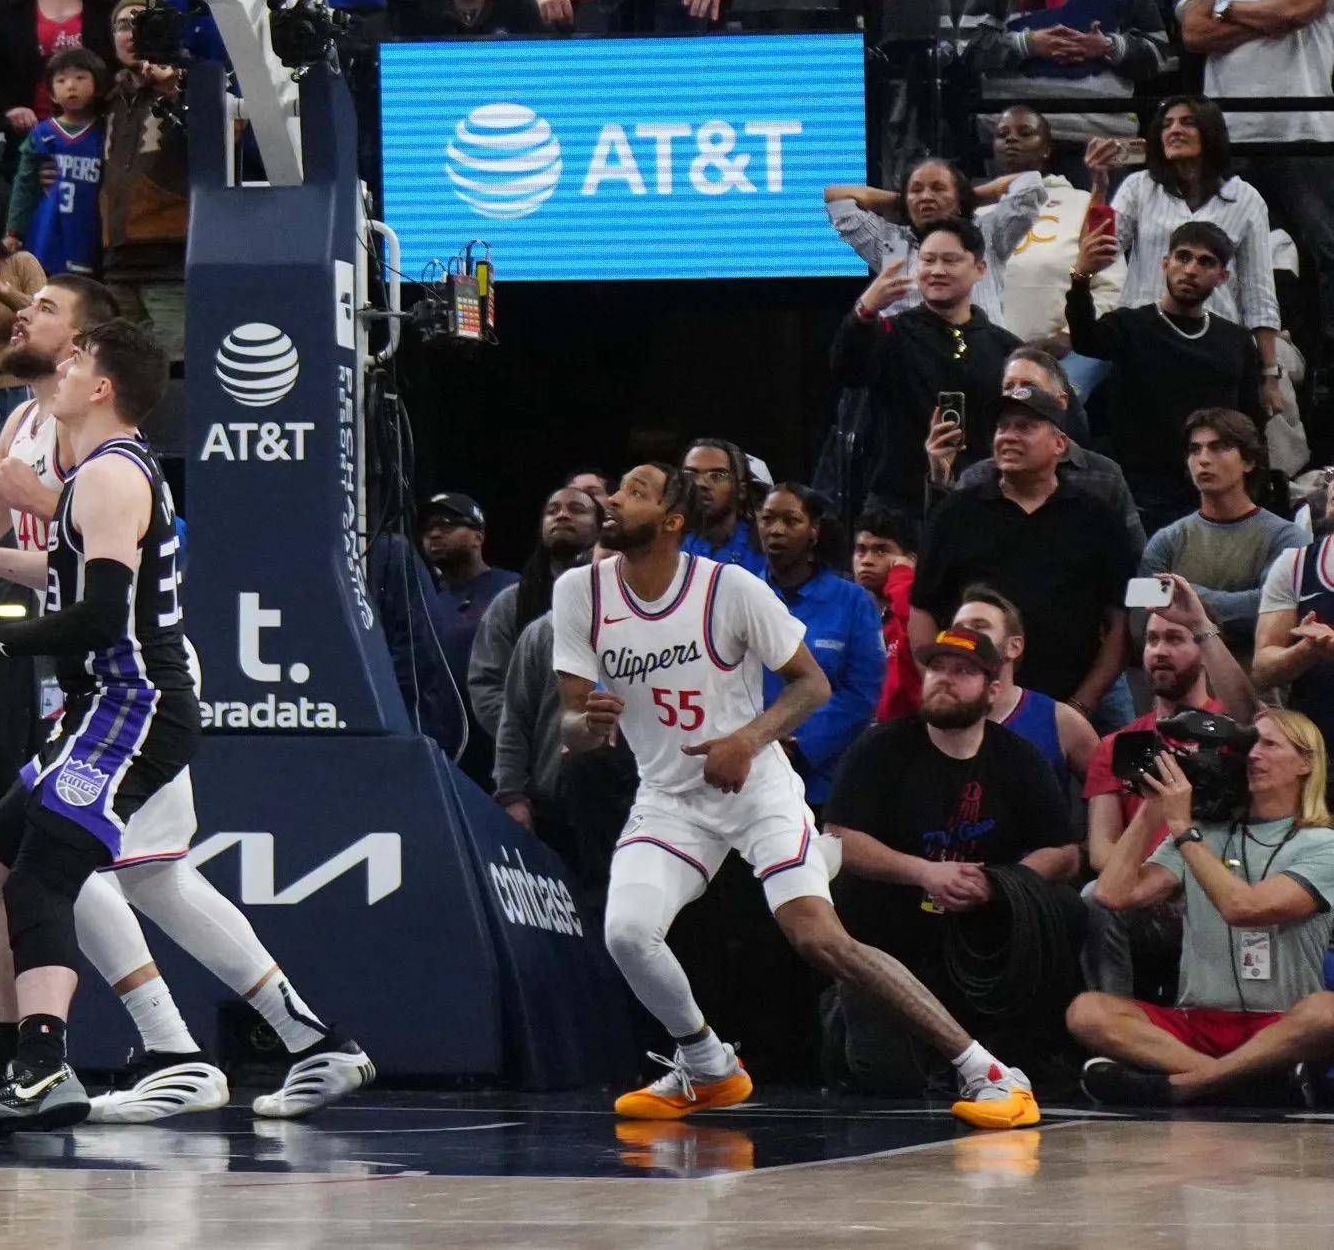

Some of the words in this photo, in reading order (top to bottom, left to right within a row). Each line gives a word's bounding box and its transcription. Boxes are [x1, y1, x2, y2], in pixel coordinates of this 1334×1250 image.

[579, 116, 806, 198] AT&T
[58, 181, 78, 214] 3
[200, 421, 317, 463] AT&T
[602, 638, 700, 685] Clippers
[652, 687, 707, 733] 55
[58, 773, 101, 797] KINGS
[488, 845, 585, 939] coinbase
